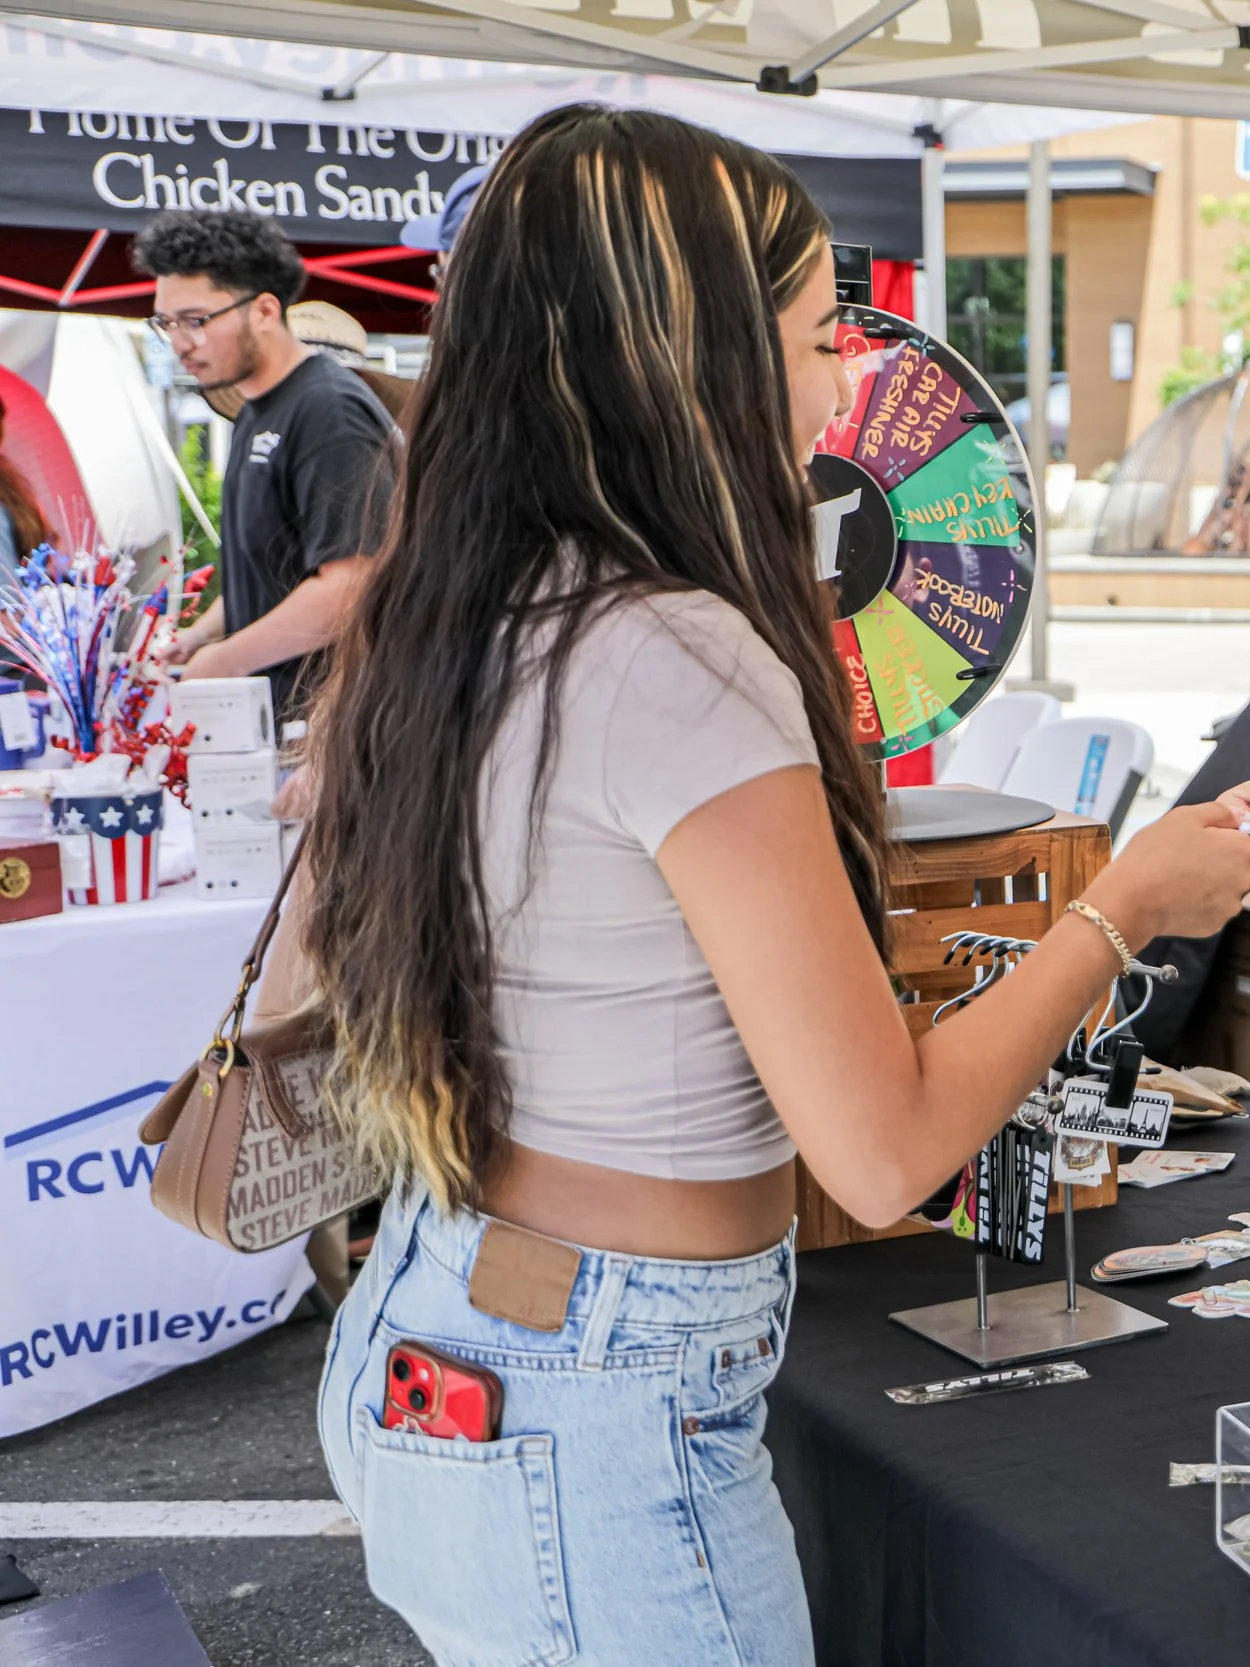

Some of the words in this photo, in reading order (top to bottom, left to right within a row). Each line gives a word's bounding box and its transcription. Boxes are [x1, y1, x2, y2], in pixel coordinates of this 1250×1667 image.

[93, 152, 307, 216] Chicken
[912, 362, 943, 405] CAR
[890, 406, 921, 448] AIR
[915, 568, 1004, 624] NOTEBOOK
[929, 602, 989, 655] TILLYS
[847, 653, 876, 733] CHOICE
[229, 1157, 326, 1219] MADDEN
[240, 1200, 312, 1248] STEVE
